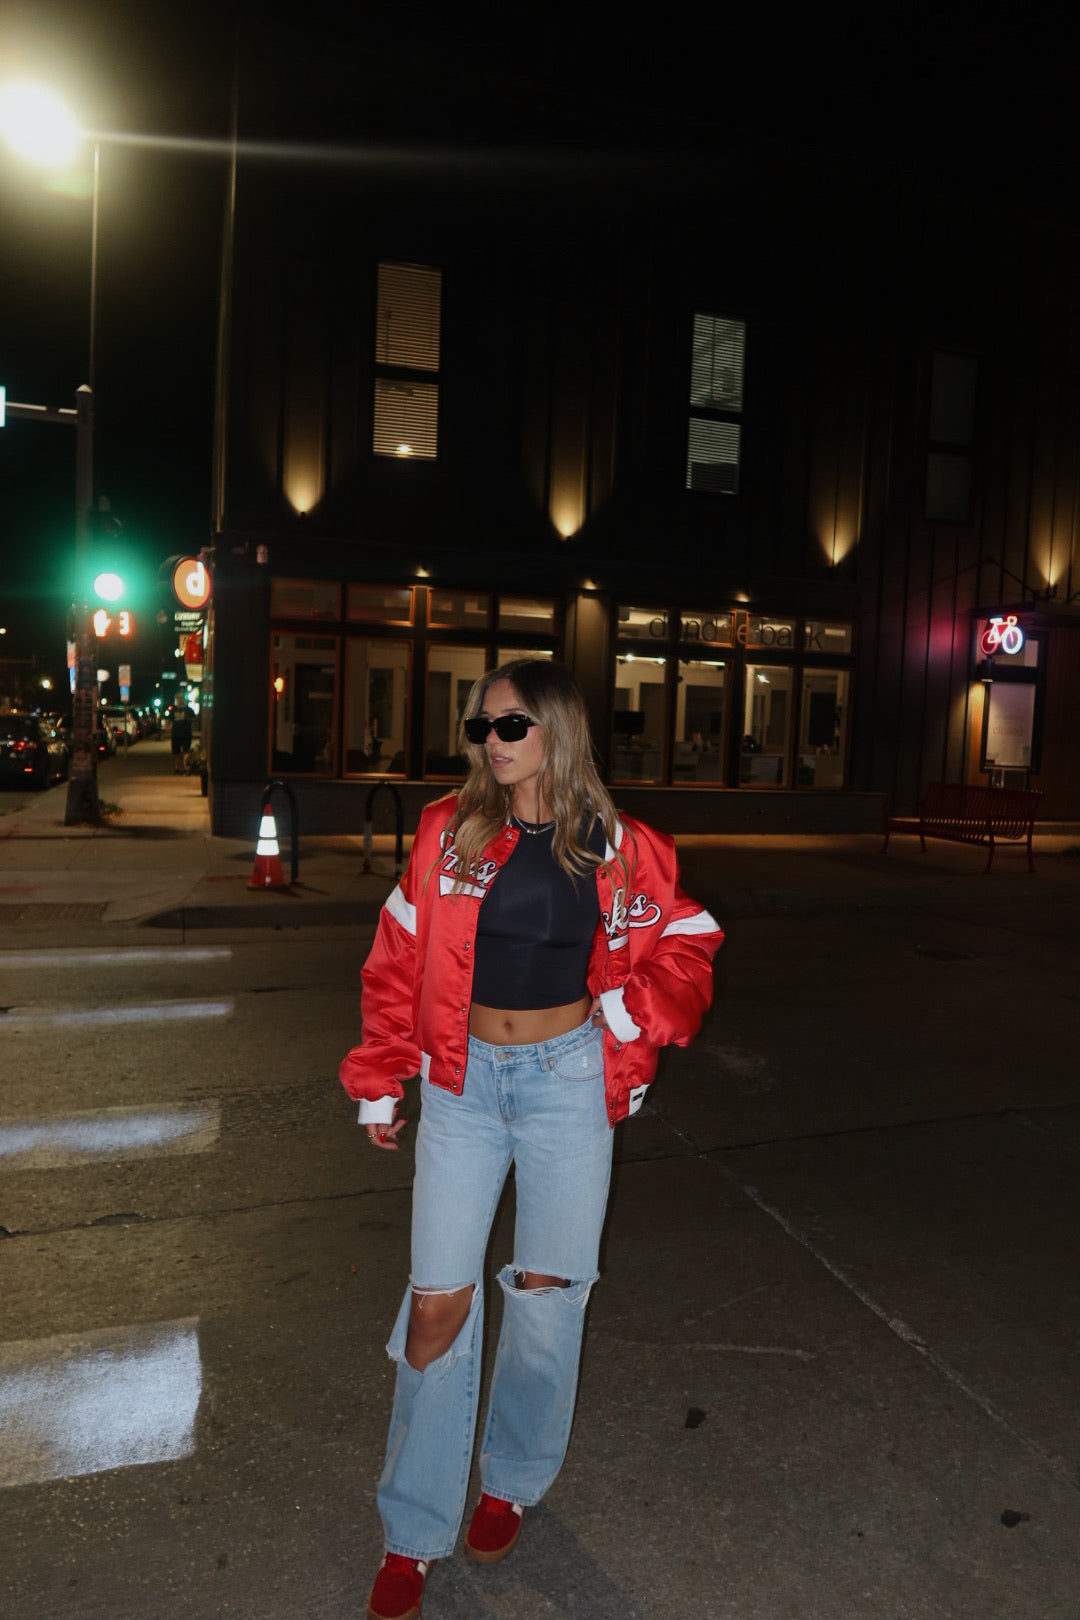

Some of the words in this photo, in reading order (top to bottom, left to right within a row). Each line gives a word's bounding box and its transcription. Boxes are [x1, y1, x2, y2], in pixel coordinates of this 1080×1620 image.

[184, 561, 204, 597] d
[648, 612, 748, 646] dnde
[760, 621, 823, 650] bak
